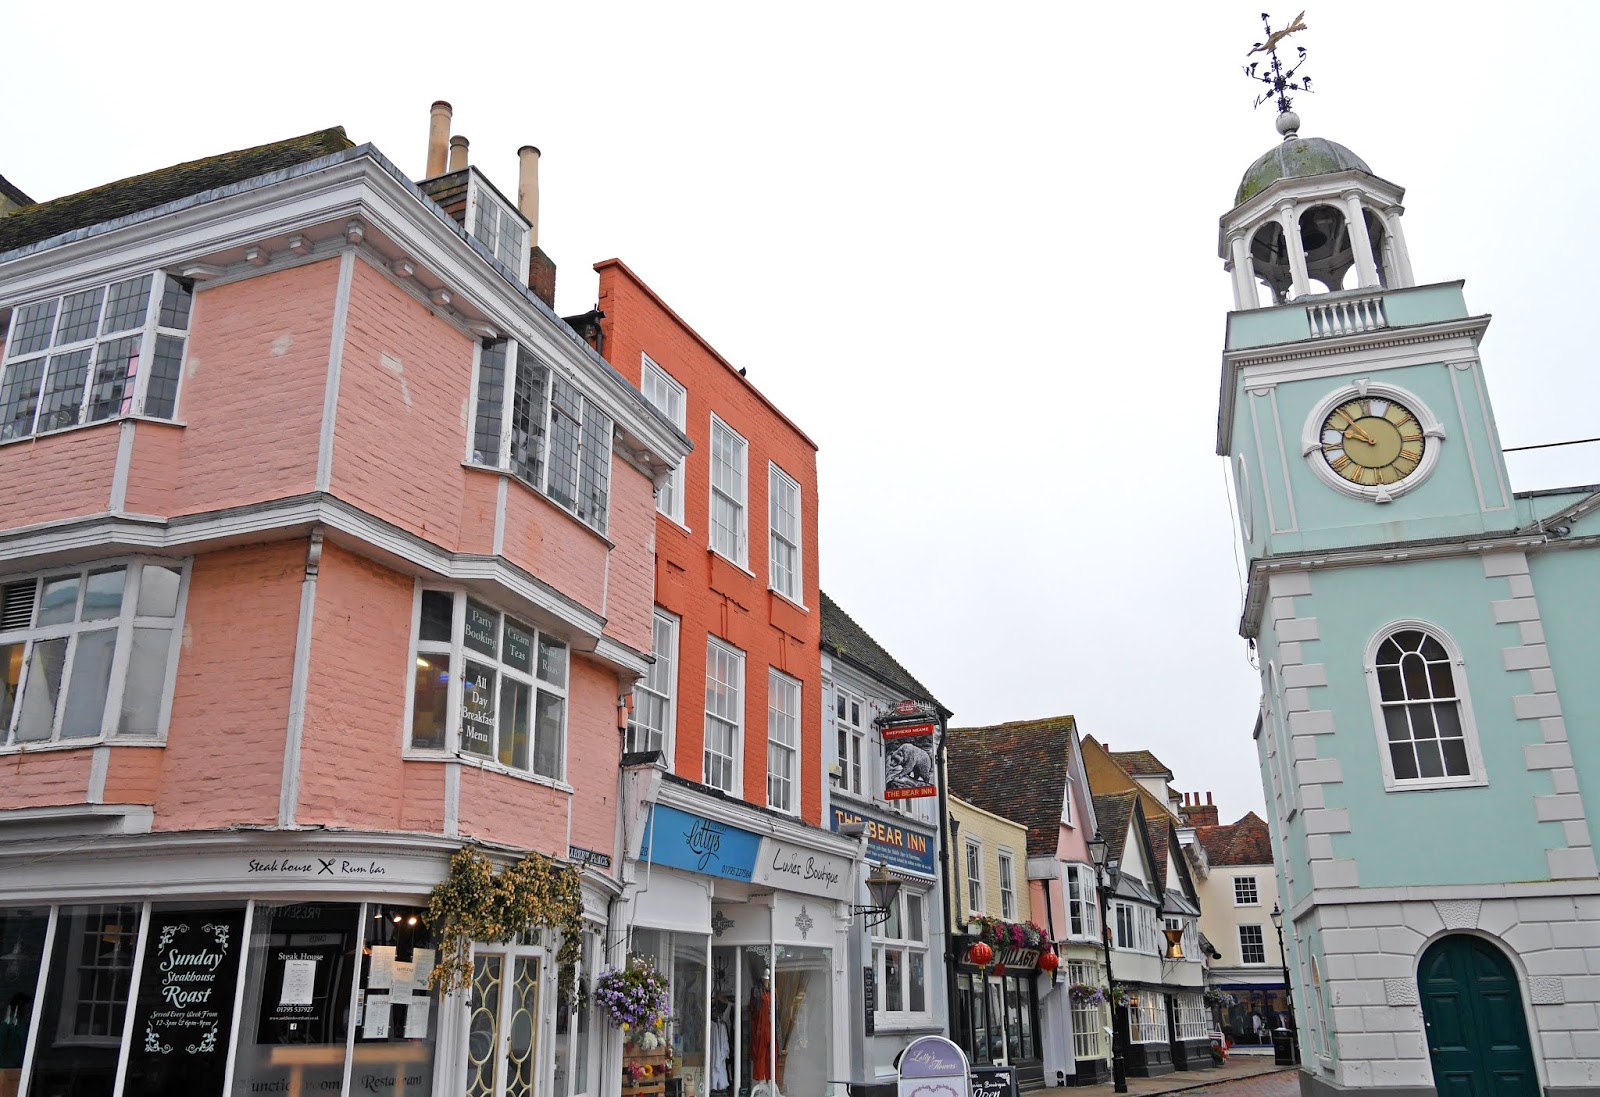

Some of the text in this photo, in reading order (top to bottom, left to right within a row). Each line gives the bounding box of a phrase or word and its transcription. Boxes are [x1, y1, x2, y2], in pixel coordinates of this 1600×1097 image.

[472, 610, 493, 629] Party
[465, 624, 497, 650] Booking
[507, 628, 530, 646] Cream
[510, 644, 526, 660] Teas
[475, 675, 487, 690] All
[472, 691, 488, 709] Day
[462, 705, 495, 727] Breakfast
[466, 725, 488, 742] Menu
[886, 787, 933, 798] THE BEAR INN
[868, 820, 903, 847] BEAR
[907, 833, 927, 853] INN
[569, 848, 590, 860] ARKET
[640, 846, 649, 857] 28
[248, 859, 386, 874] Steak house Rum bar
[803, 856, 839, 889] Boutique
[160, 948, 223, 972] Sunday
[278, 952, 298, 960] Steak
[1000, 949, 1038, 968] VILLAGE
[162, 971, 215, 985] Steakhouse
[162, 985, 211, 1009] Roast
[150, 1011, 170, 1020] Served
[170, 1011, 185, 1020] Every
[929, 1059, 956, 1070] Flowers
